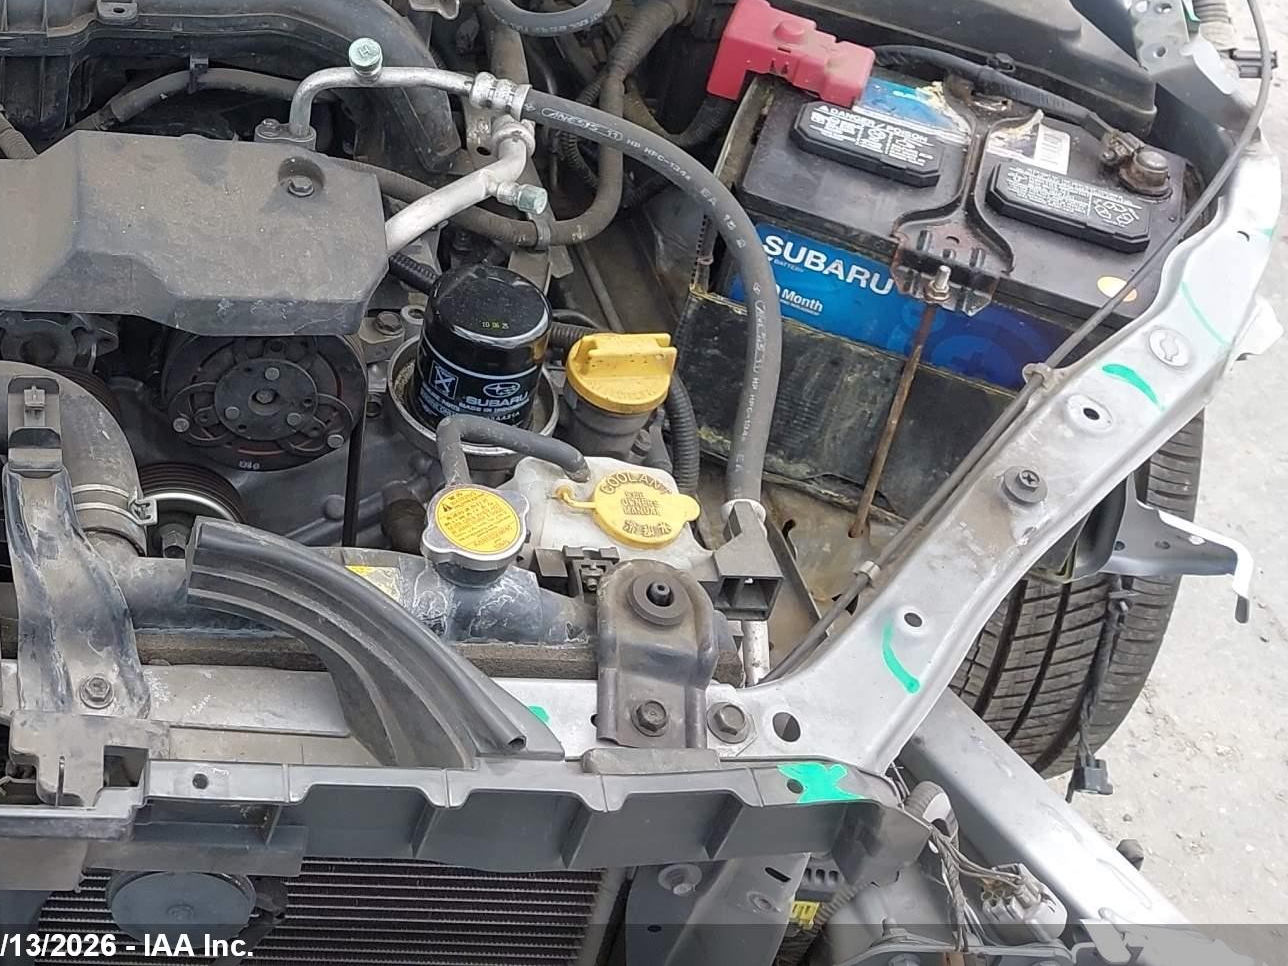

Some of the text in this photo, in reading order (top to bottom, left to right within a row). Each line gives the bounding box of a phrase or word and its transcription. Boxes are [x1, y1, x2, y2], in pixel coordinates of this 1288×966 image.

[830, 107, 875, 127] DANGER
[886, 122, 929, 143] POISON
[762, 234, 895, 296] SUBARU
[773, 259, 805, 274] BATTERY
[781, 287, 824, 313] Month
[465, 391, 528, 407] SUBARU
[599, 471, 673, 496] COOLANT
